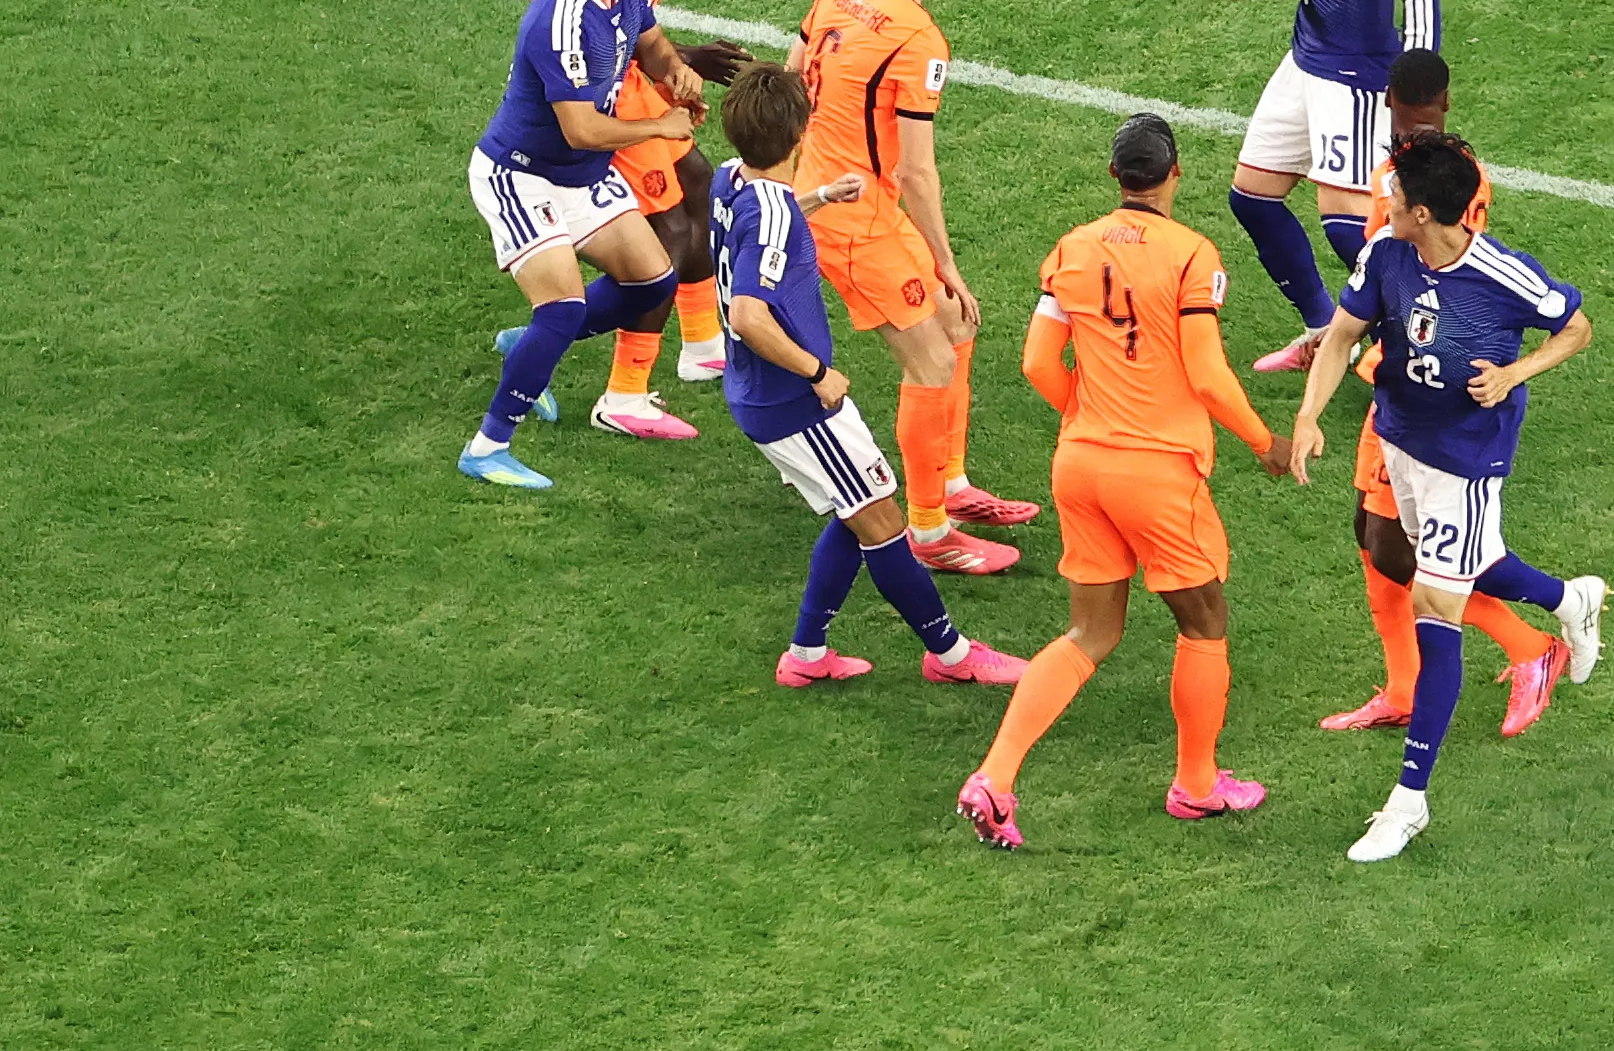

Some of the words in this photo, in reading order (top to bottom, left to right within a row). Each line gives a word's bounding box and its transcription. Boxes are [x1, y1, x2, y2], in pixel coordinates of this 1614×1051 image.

[1319, 133, 1350, 173] 15
[1101, 225, 1148, 245] VIRGIL
[1101, 261, 1139, 361] 4
[1420, 517, 1460, 564] 22
